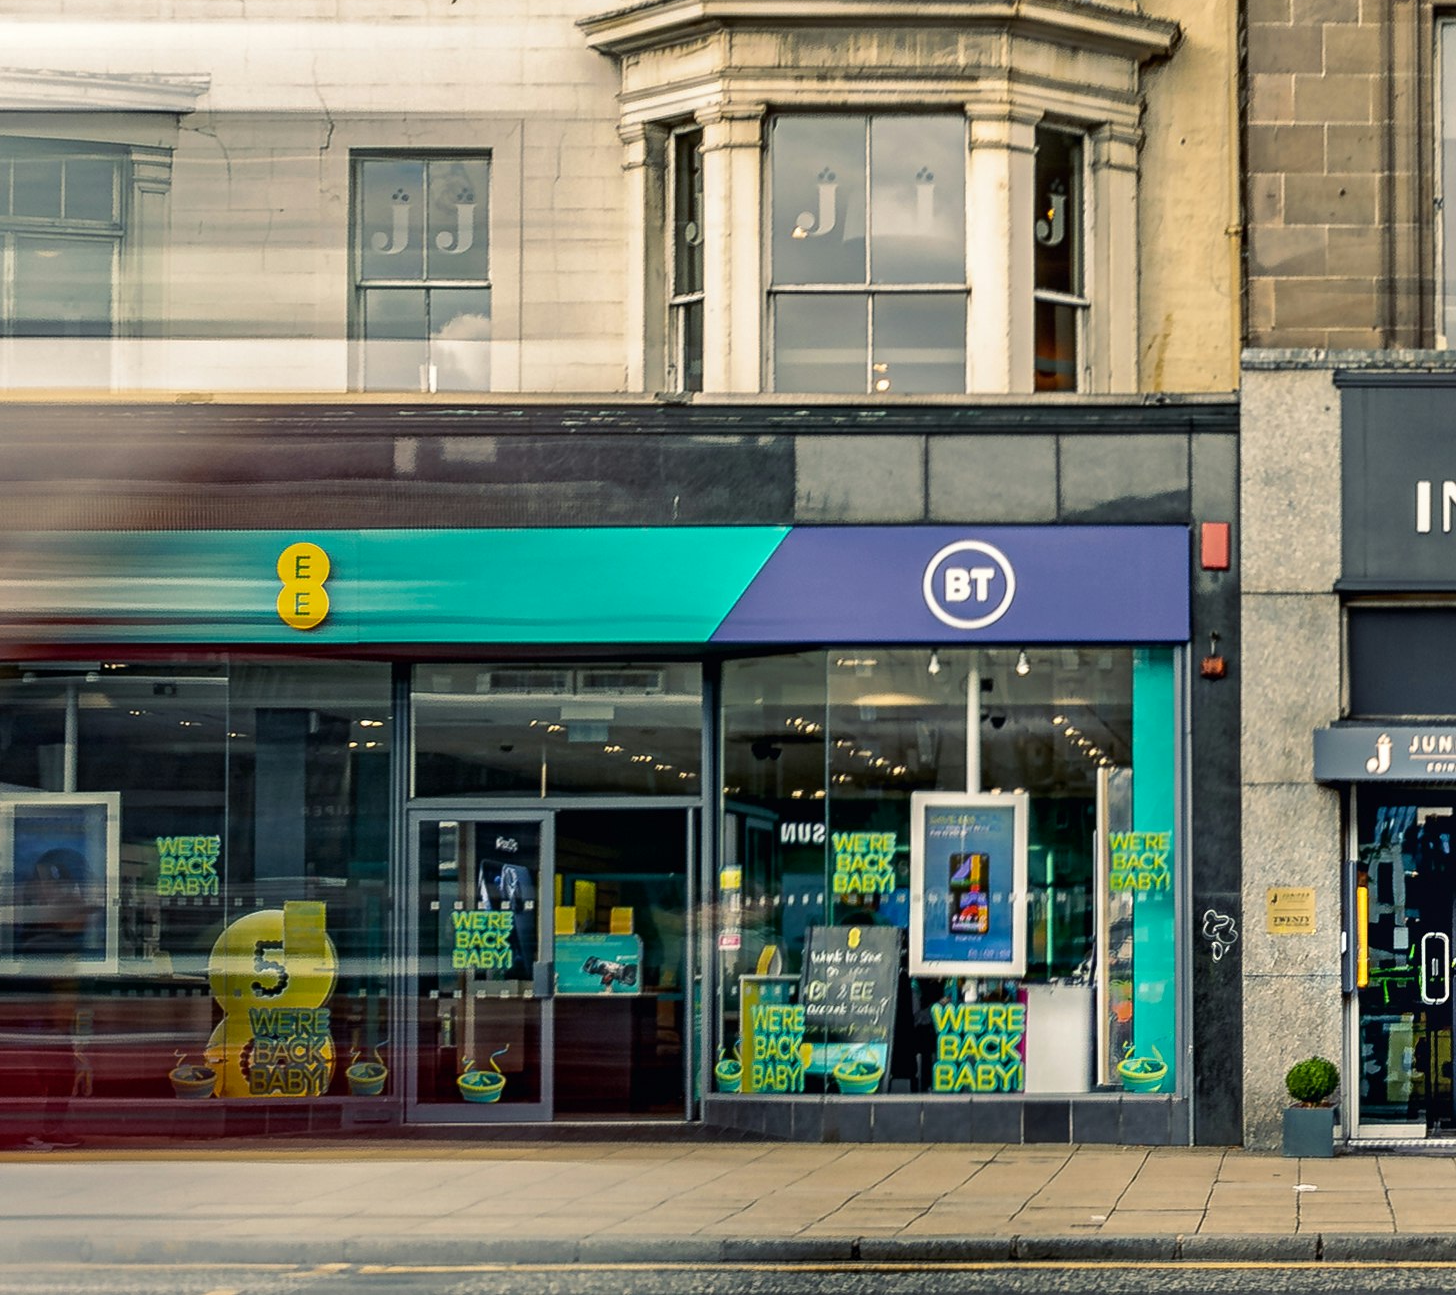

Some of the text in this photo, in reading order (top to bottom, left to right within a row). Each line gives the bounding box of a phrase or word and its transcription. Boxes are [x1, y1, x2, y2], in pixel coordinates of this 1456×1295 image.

[945, 567, 995, 602] BT
[156, 835, 221, 857] WE'RE
[832, 831, 897, 853] WE'RE
[1109, 830, 1172, 851] WE'RE
[159, 857, 218, 876] BACK
[835, 852, 894, 873] BACK
[1112, 852, 1168, 871] BACK
[157, 876, 219, 896] BABY!
[833, 872, 895, 894] BABY!
[1110, 872, 1171, 892] BABY!
[451, 911, 514, 931] WE'RE
[1273, 915, 1311, 923] TWENTY
[455, 930, 511, 950] BACK
[452, 950, 513, 969] BABY!
[249, 1008, 331, 1036] WE'RE
[750, 1003, 806, 1033] WE'RE
[931, 1002, 1026, 1033] WE'RE
[252, 1036, 327, 1064] BACK
[752, 1033, 804, 1061] BACK
[936, 1033, 1023, 1061] BACK
[249, 1064, 329, 1095] BABY!
[750, 1061, 806, 1093] BABY!
[932, 1061, 1024, 1094] BABY!
